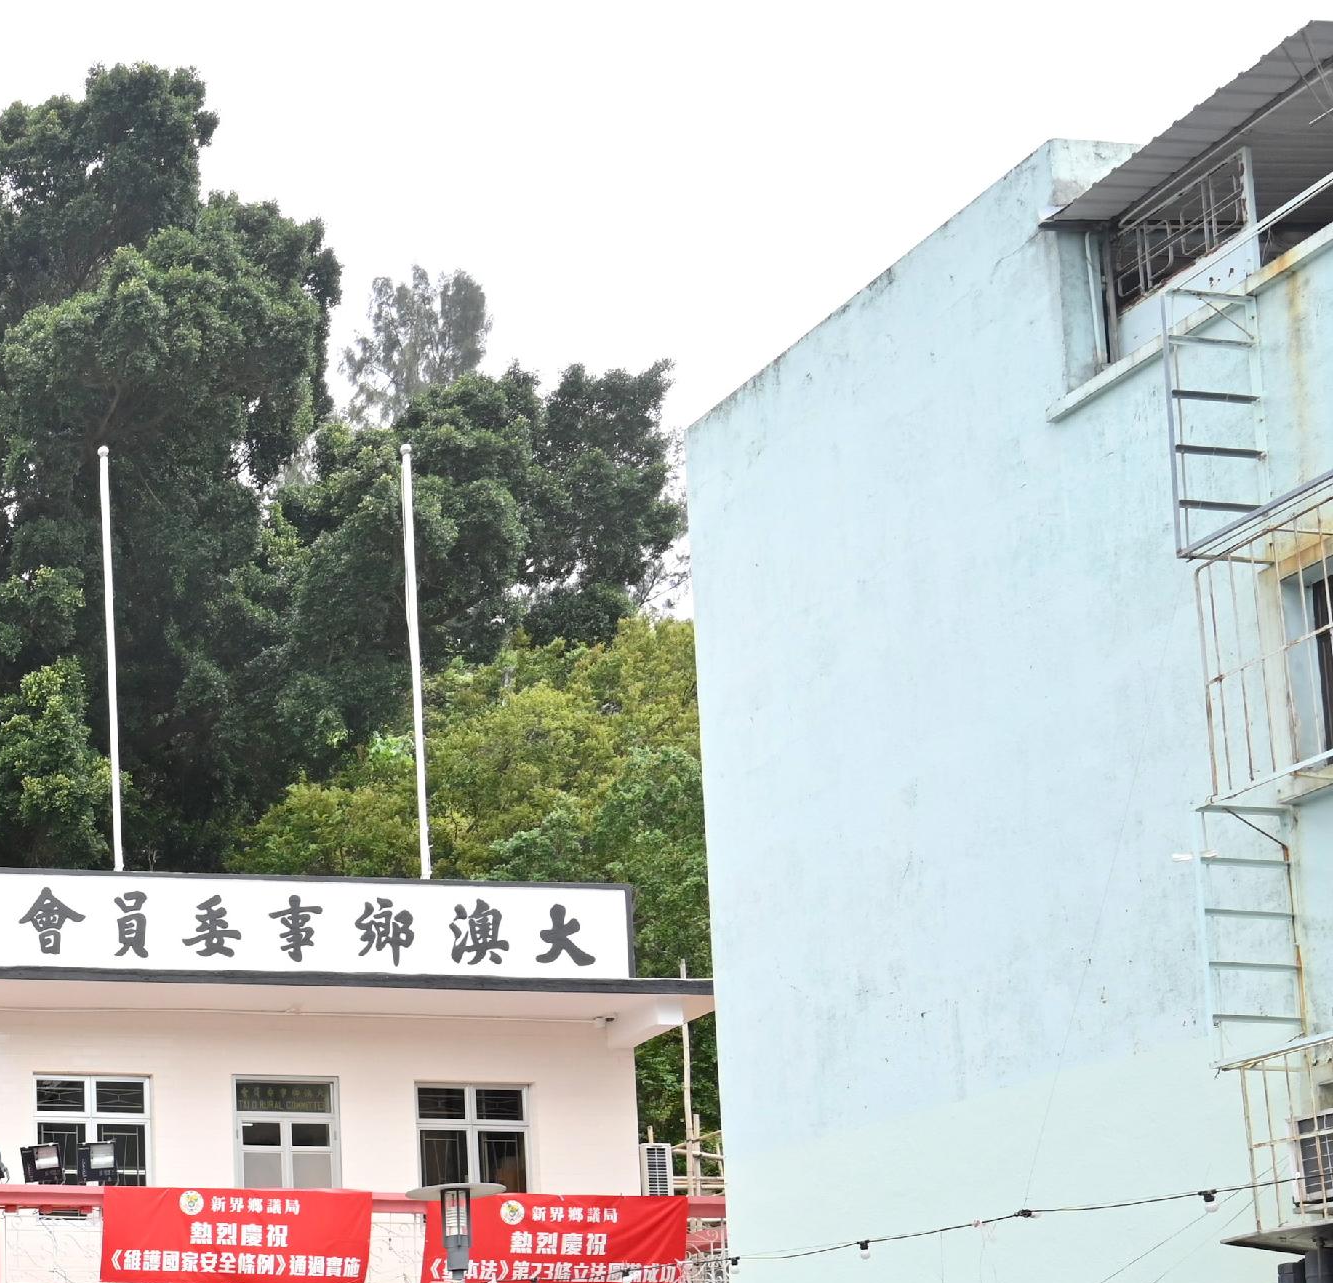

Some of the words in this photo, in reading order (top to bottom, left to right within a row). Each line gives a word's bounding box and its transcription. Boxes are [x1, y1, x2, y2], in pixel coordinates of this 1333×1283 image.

[19, 887, 595, 966] 大澳鄉事委員會
[211, 1195, 301, 1216] 新界鄉議局
[531, 1205, 619, 1224] 新界鄉議局
[189, 1221, 289, 1248] 熱烈慶祝
[509, 1231, 608, 1256] 熱烈慶祝
[111, 1249, 362, 1278] 《維護國家安全條例》通過實施
